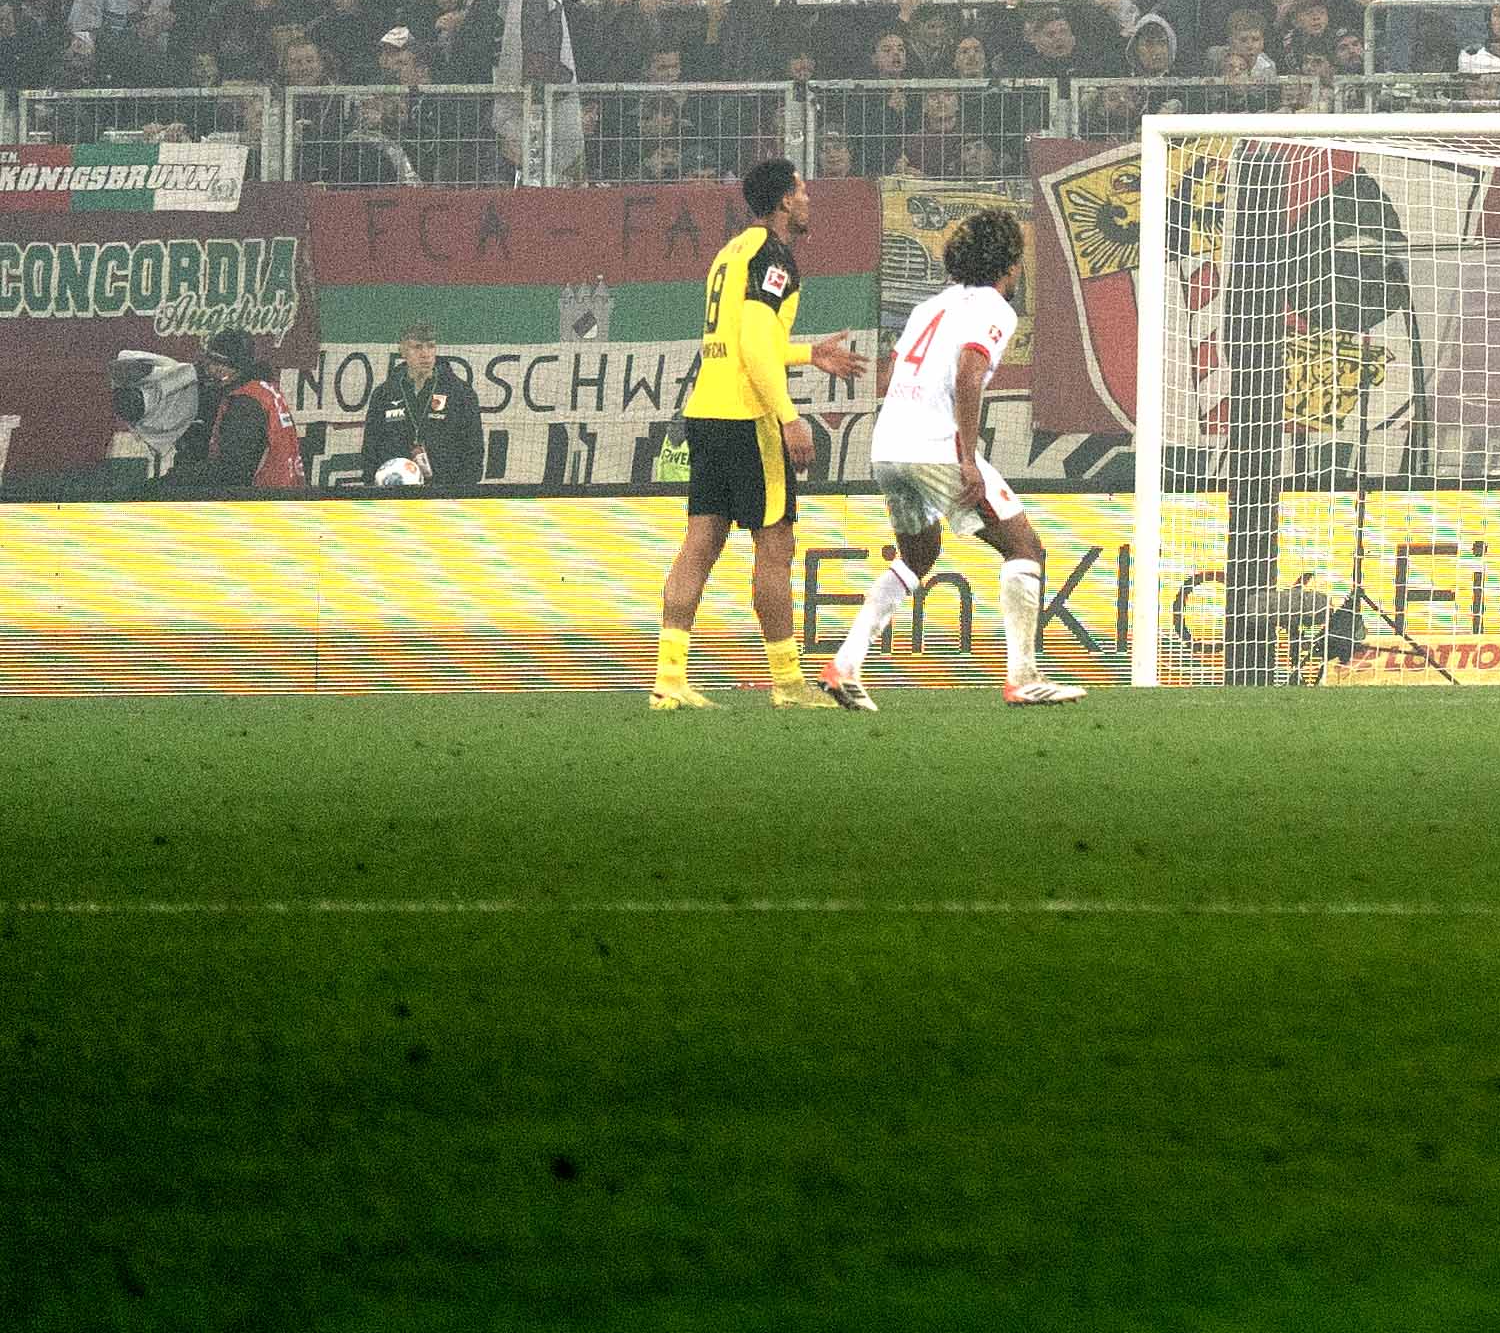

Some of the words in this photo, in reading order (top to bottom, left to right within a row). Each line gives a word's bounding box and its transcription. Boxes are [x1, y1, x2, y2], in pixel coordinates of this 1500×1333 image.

[0, 164, 219, 192] KÖNIGSBRUNN
[706, 262, 728, 334] 8
[904, 309, 945, 376] 4
